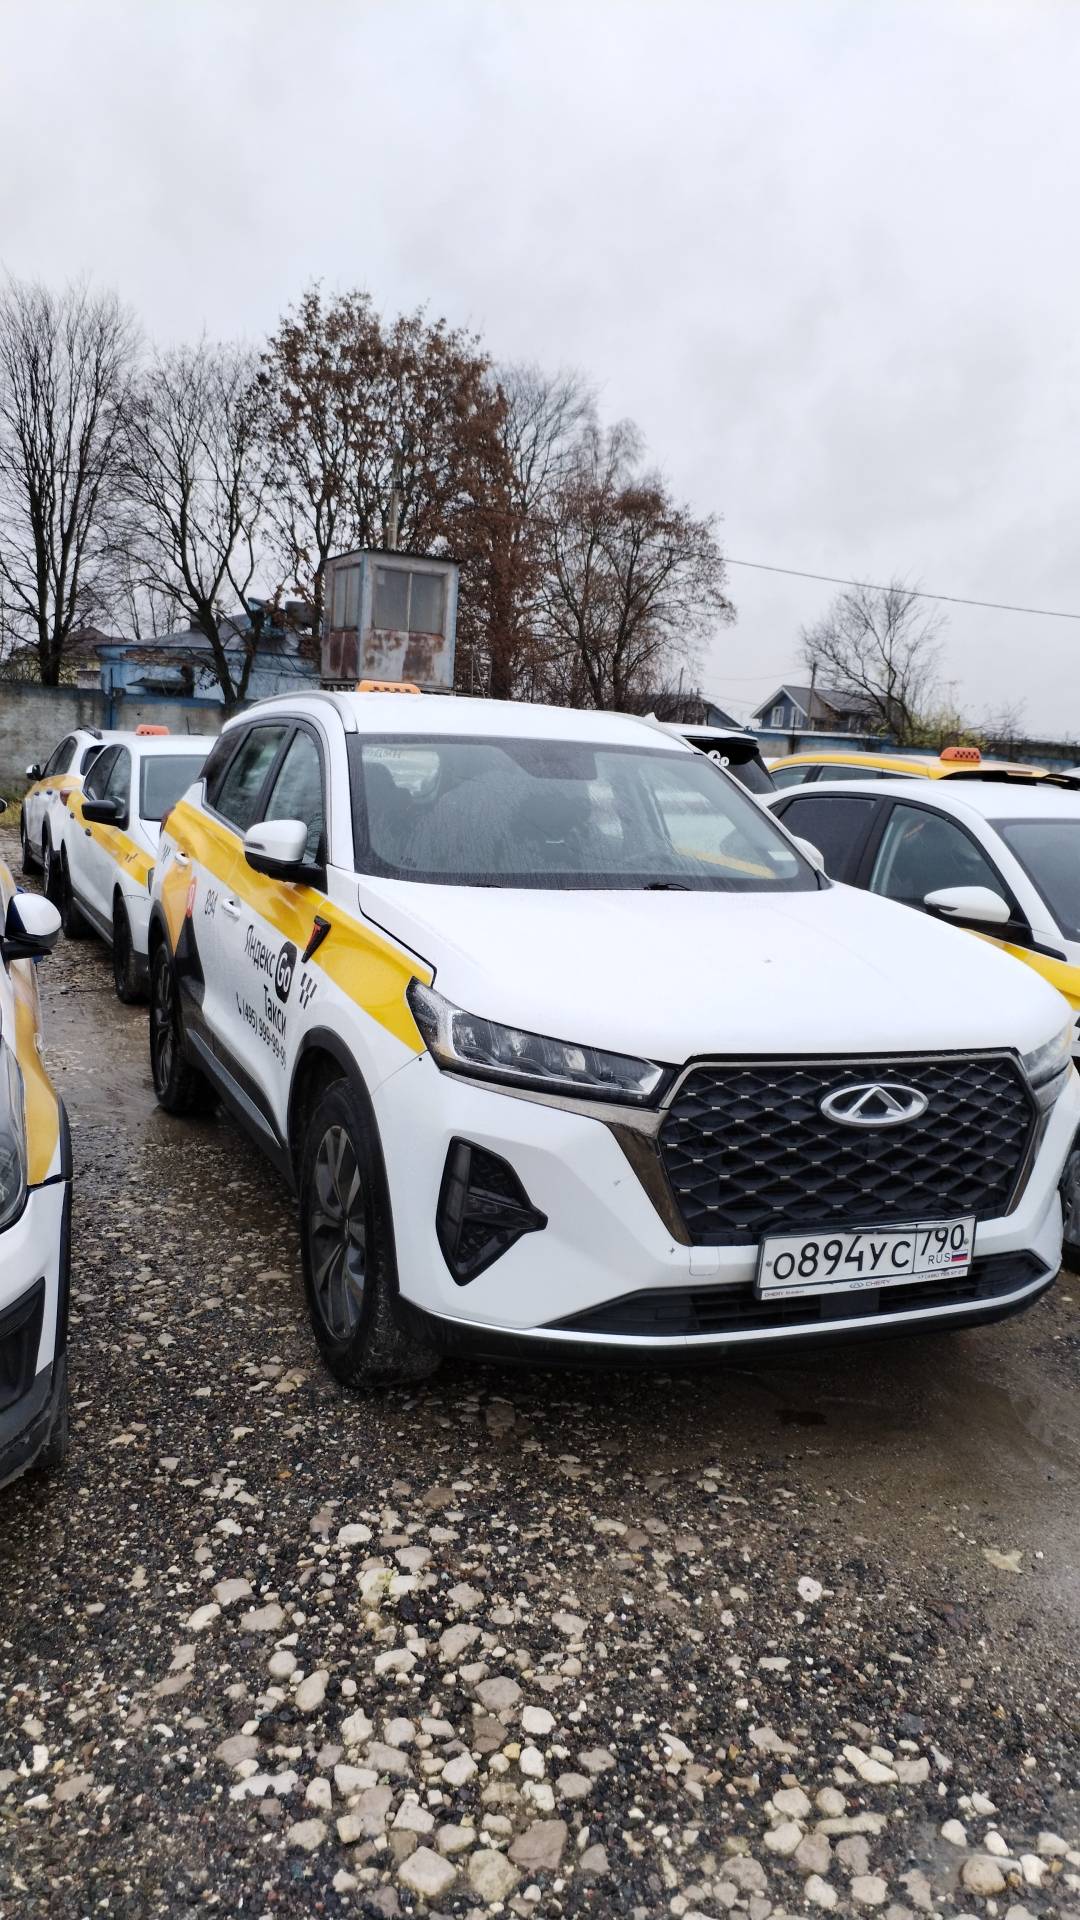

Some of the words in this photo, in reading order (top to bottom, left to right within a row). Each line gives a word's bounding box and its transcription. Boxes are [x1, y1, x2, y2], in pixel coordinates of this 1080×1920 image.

[244, 924, 276, 978] Яндекс
[276, 952, 292, 993] Go
[242, 998, 258, 1035] (495)
[263, 984, 287, 1040] Такси
[773, 1234, 912, 1281] О894УС
[927, 1253, 951, 1266] RUS
[865, 1279, 891, 1287] CHERY
